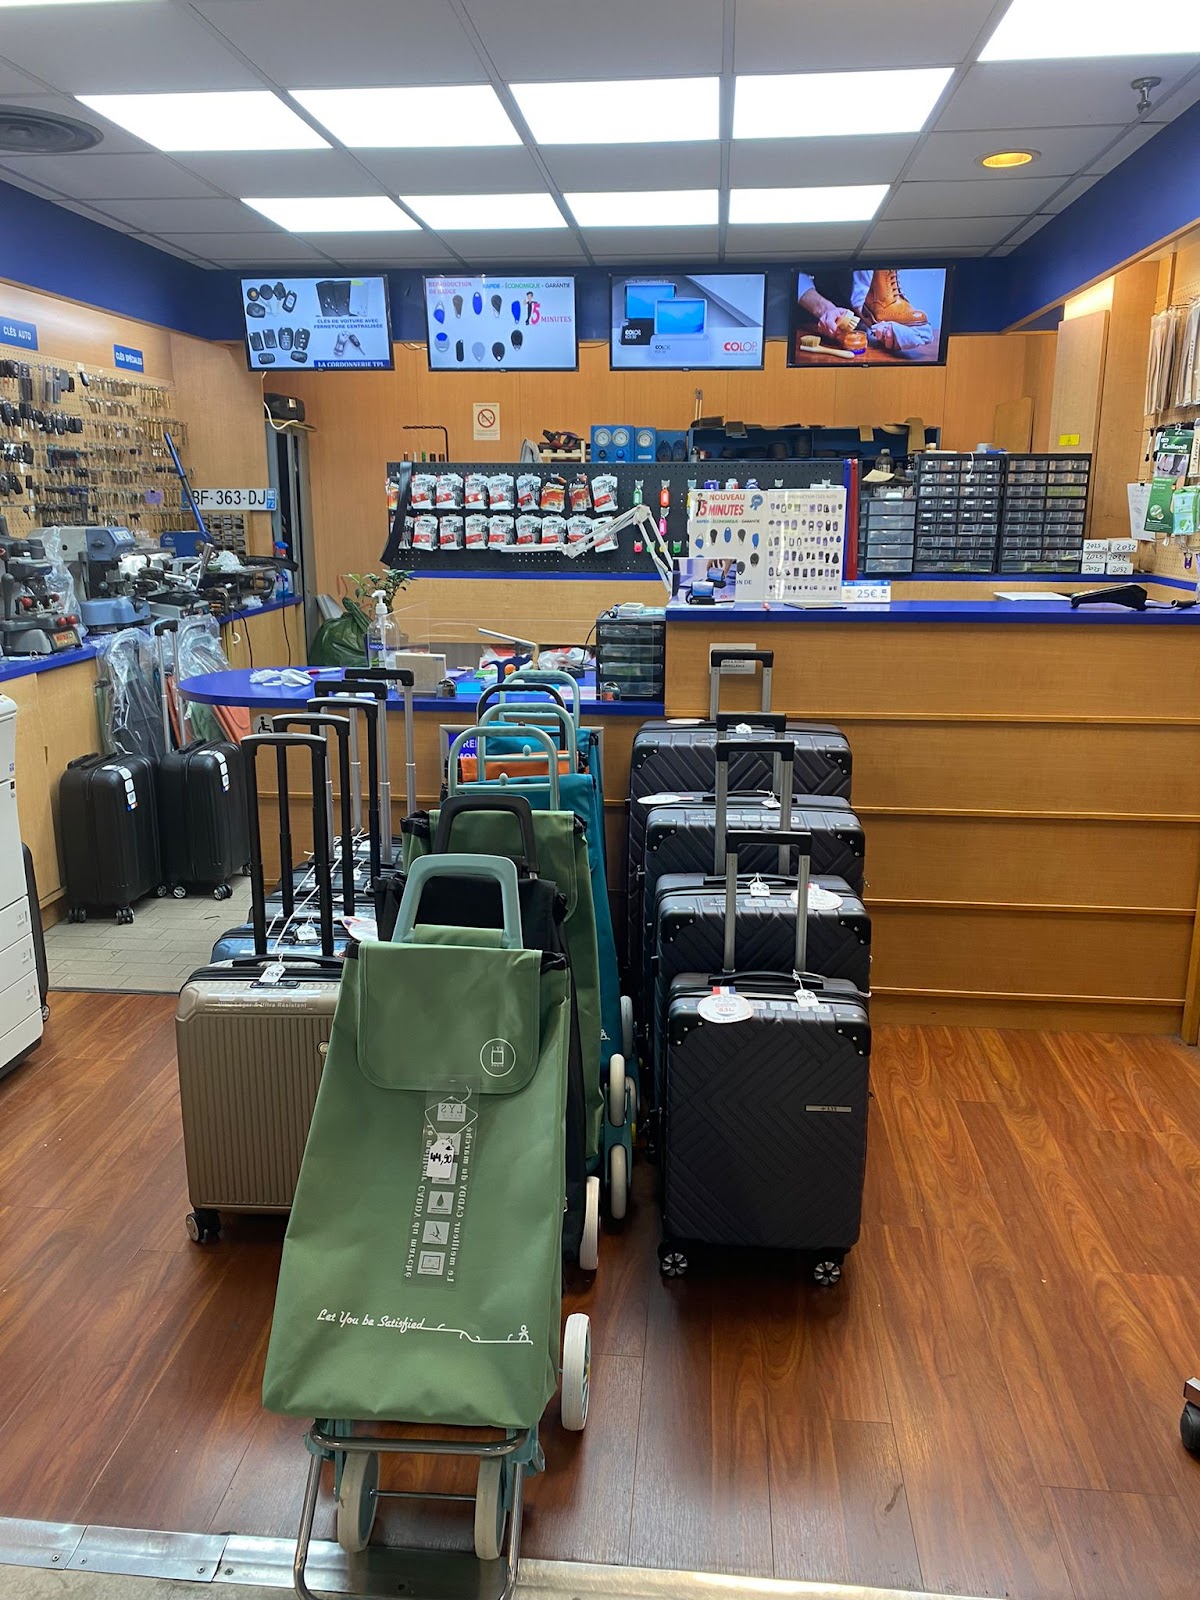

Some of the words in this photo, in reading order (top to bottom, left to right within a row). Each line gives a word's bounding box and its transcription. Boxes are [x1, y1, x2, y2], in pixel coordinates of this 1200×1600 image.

[3, 325, 17, 337] CLÉS
[18, 329, 32, 340] AUTO
[724, 341, 758, 352] COLOP
[327, 360, 373, 368] CORDONNERIE
[709, 493, 746, 501] NOUVEAU
[267, 500, 274, 508] 72
[708, 504, 745, 516] MINUTES
[857, 588, 878, 598] 25€
[430, 1151, 453, 1166] 44,90
[317, 1308, 336, 1322] Let
[339, 1311, 359, 1328] You
[361, 1314, 375, 1326] be
[377, 1315, 426, 1334] Satisfied
